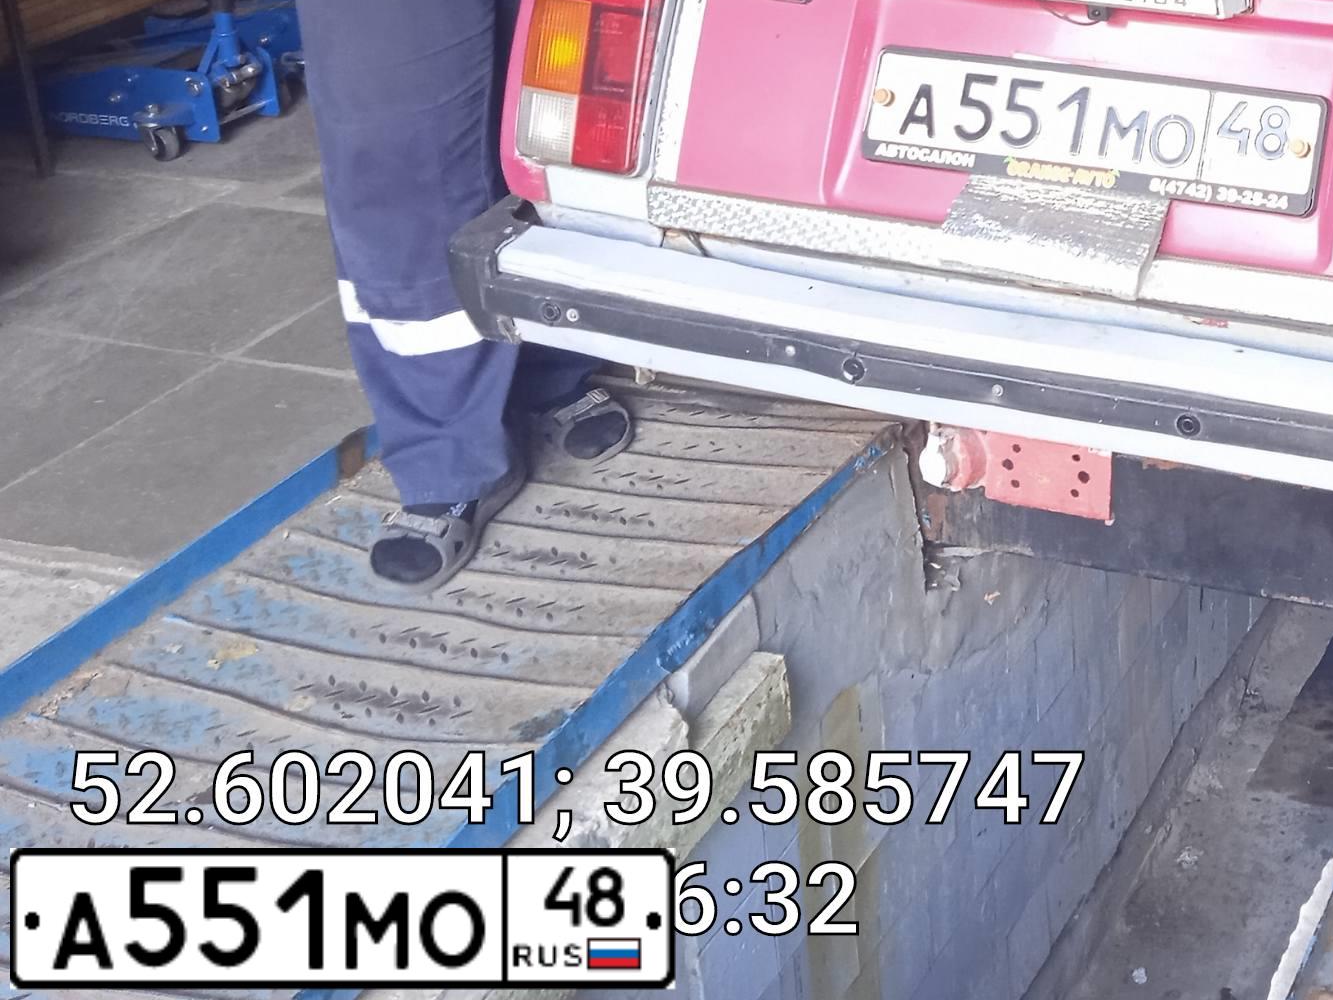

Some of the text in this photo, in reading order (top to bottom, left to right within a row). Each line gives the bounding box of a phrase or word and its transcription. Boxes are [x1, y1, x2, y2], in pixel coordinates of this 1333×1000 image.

[899, 72, 1291, 169] А551МО 48
[874, 144, 976, 168] АВТОСАЛОН
